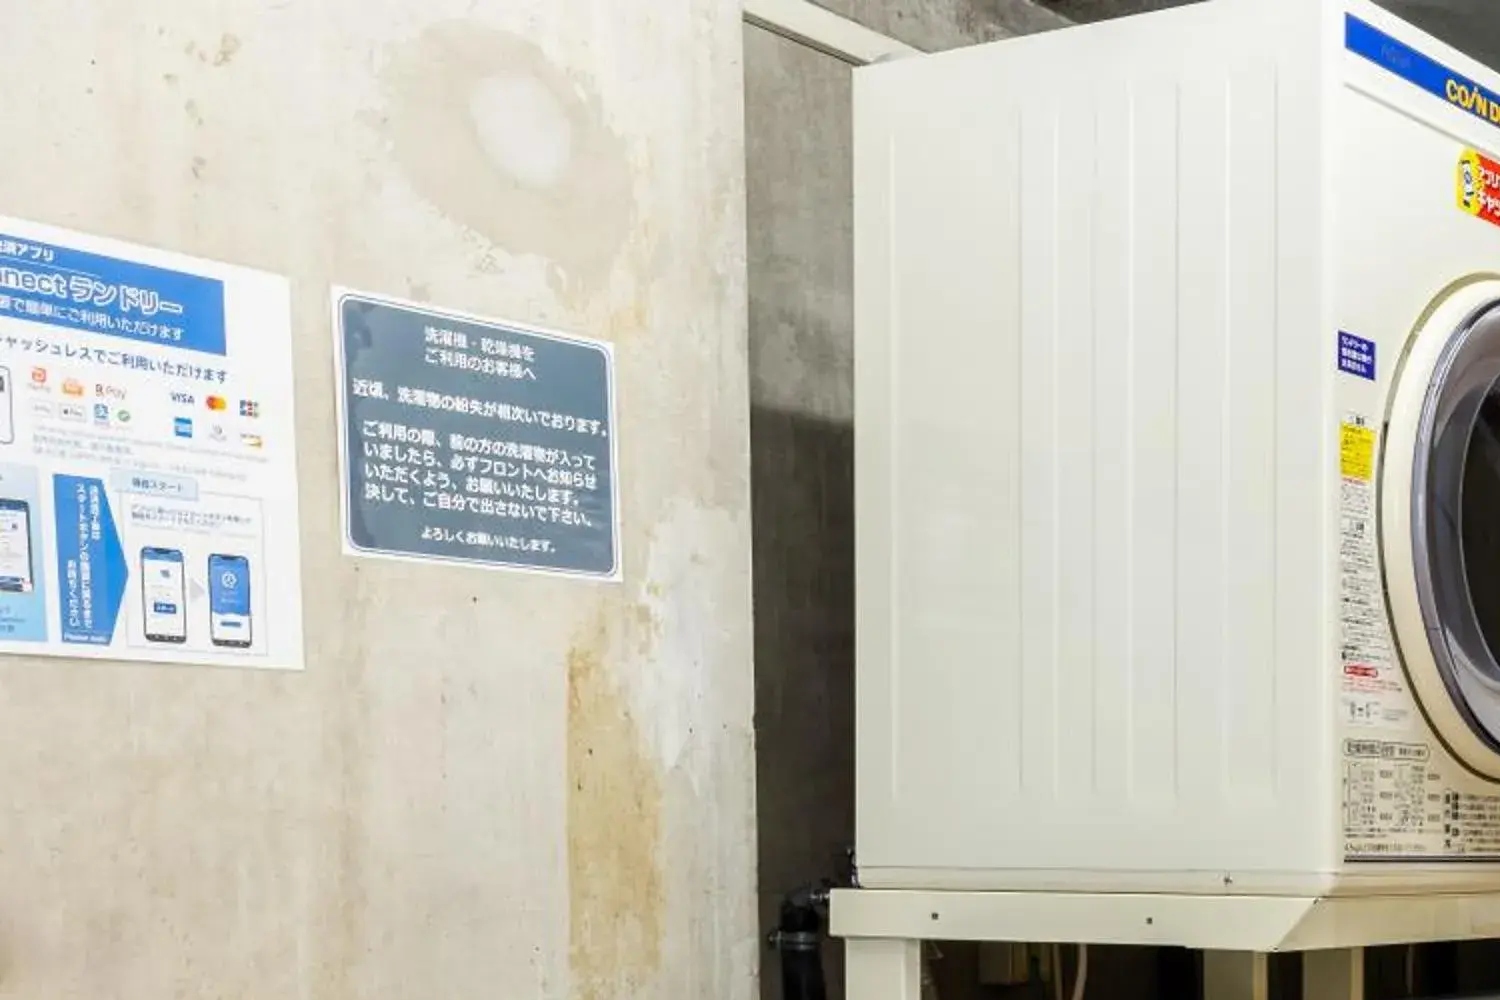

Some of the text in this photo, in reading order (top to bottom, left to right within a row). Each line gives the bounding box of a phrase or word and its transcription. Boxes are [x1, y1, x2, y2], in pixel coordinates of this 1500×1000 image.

[69, 275, 184, 315] ランドリー
[424, 348, 536, 380] ご利用のお客様へ
[171, 391, 195, 405] VISA
